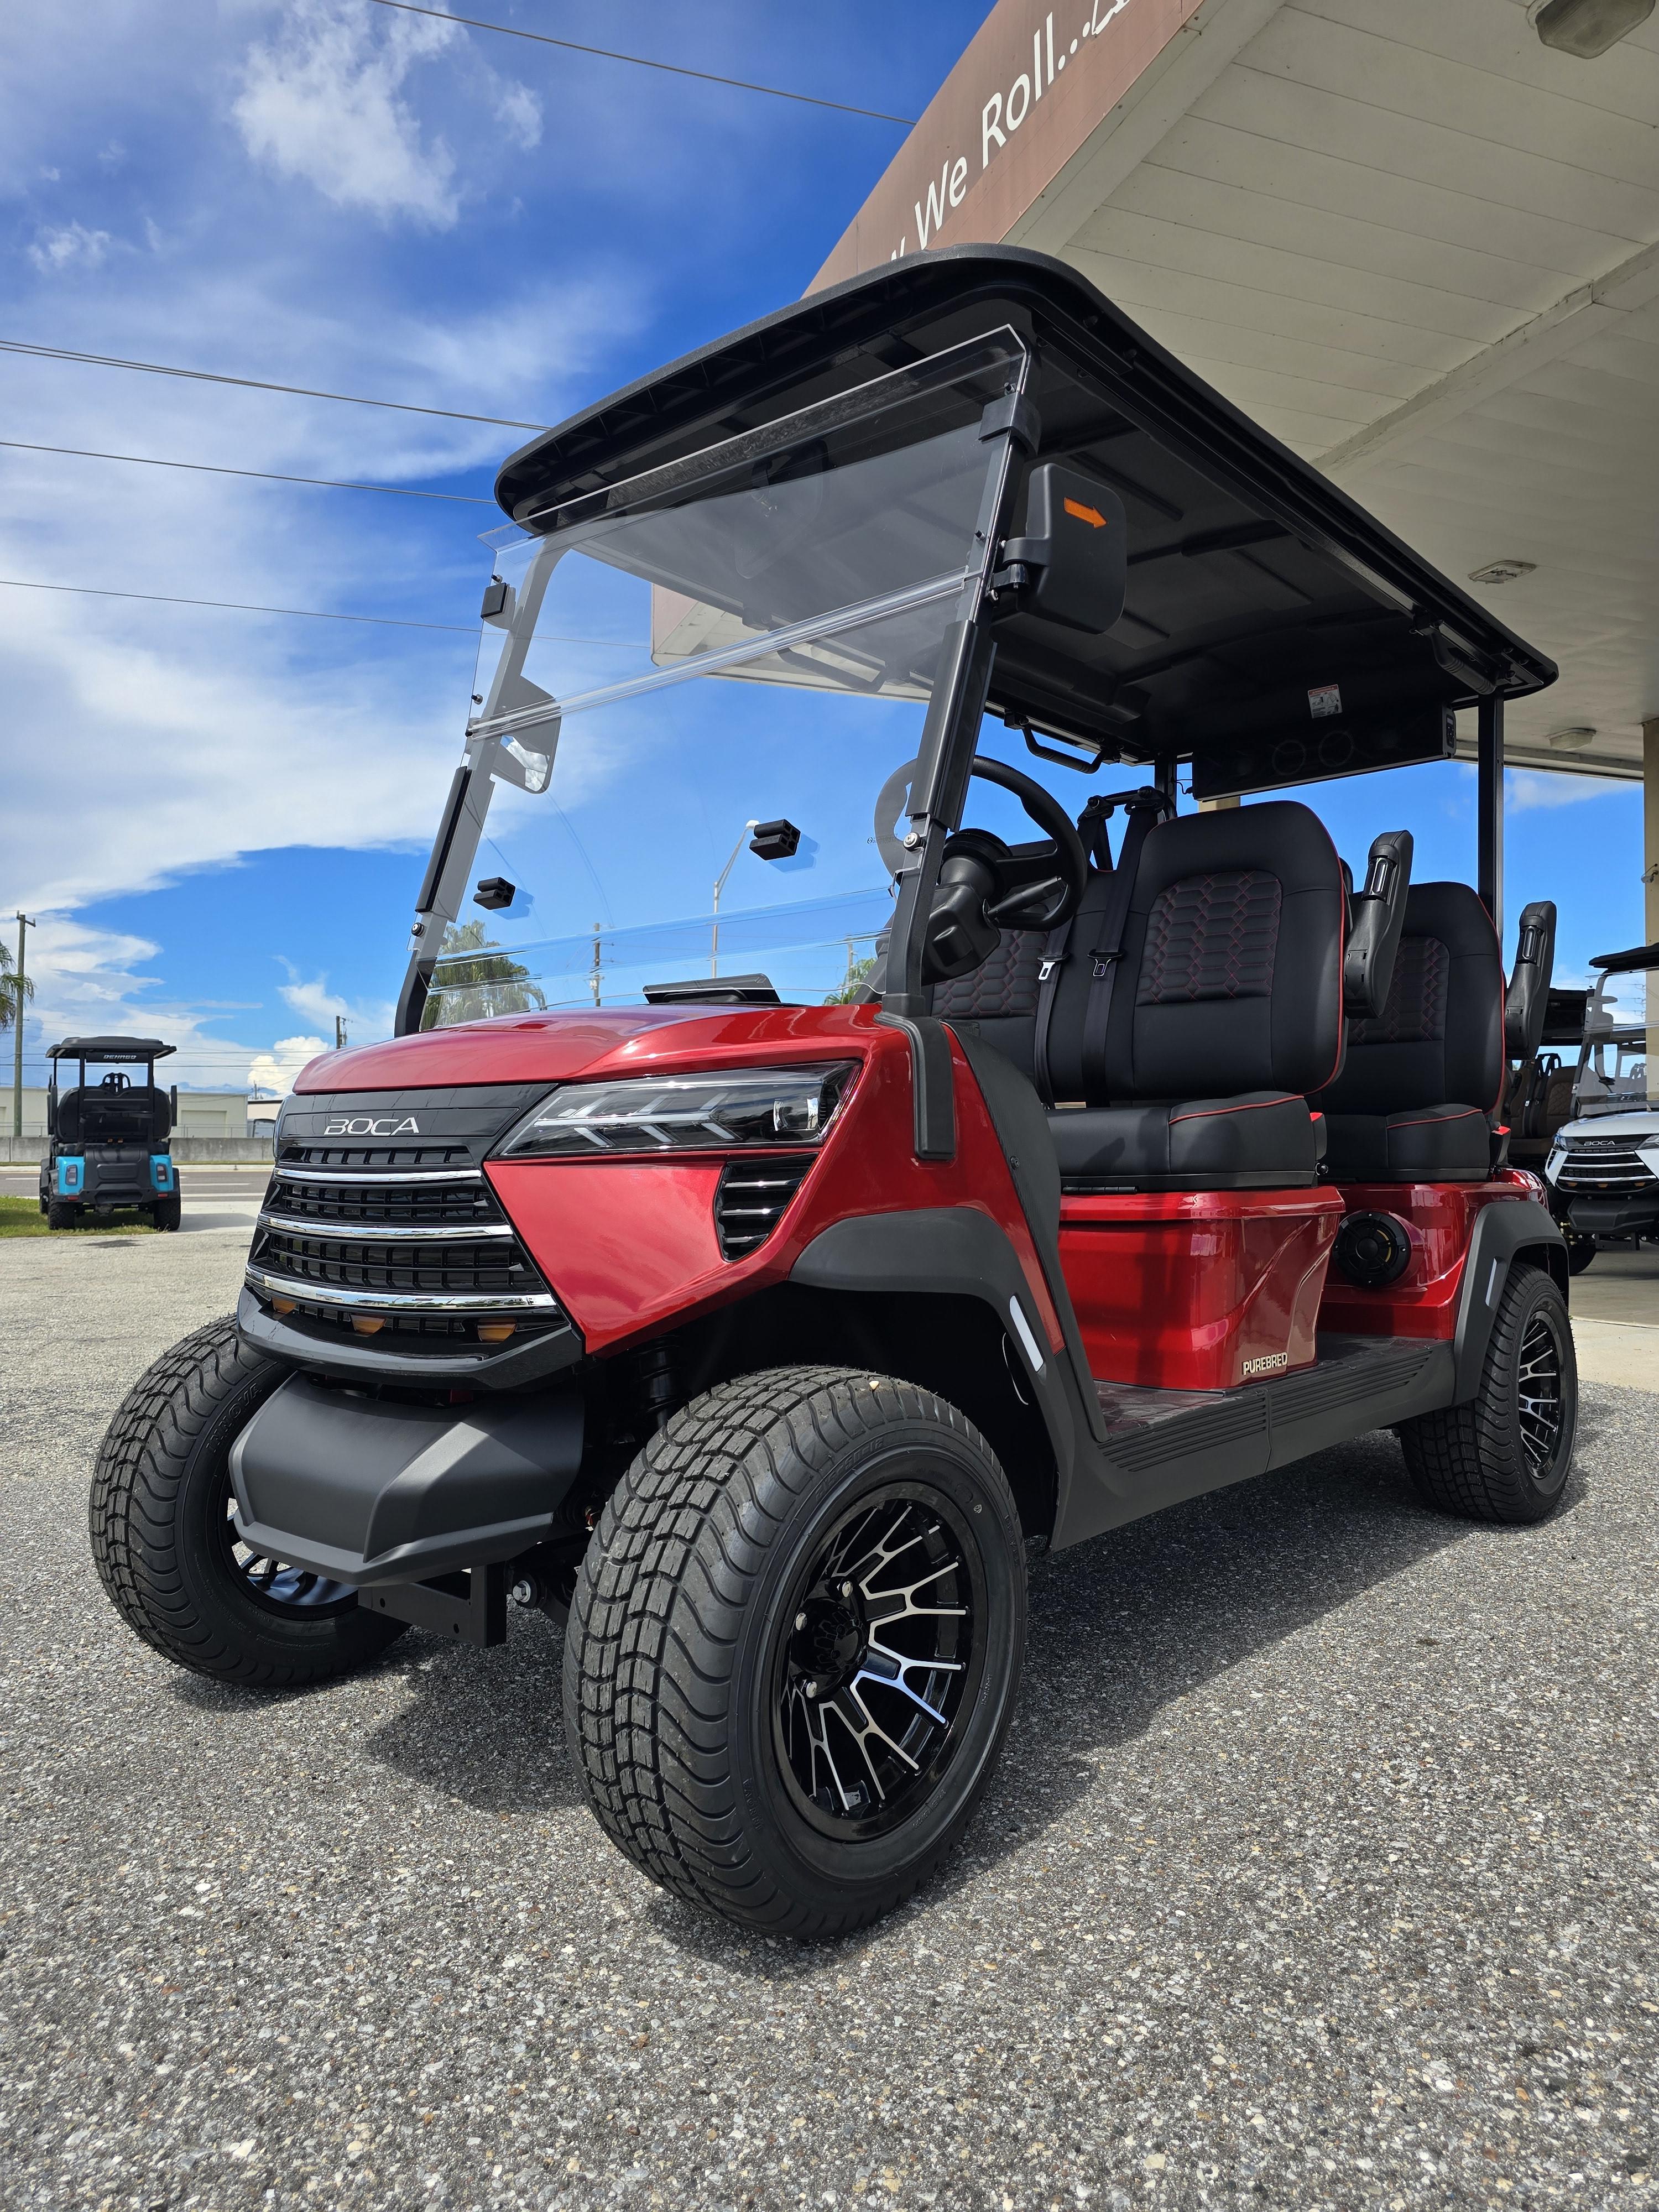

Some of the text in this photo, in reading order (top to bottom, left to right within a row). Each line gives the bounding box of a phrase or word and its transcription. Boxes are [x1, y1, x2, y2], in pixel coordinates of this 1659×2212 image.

[915, 156, 967, 250] We
[324, 1117, 420, 1136] BOCA
[1243, 1352, 1287, 1375] PUREBRED
